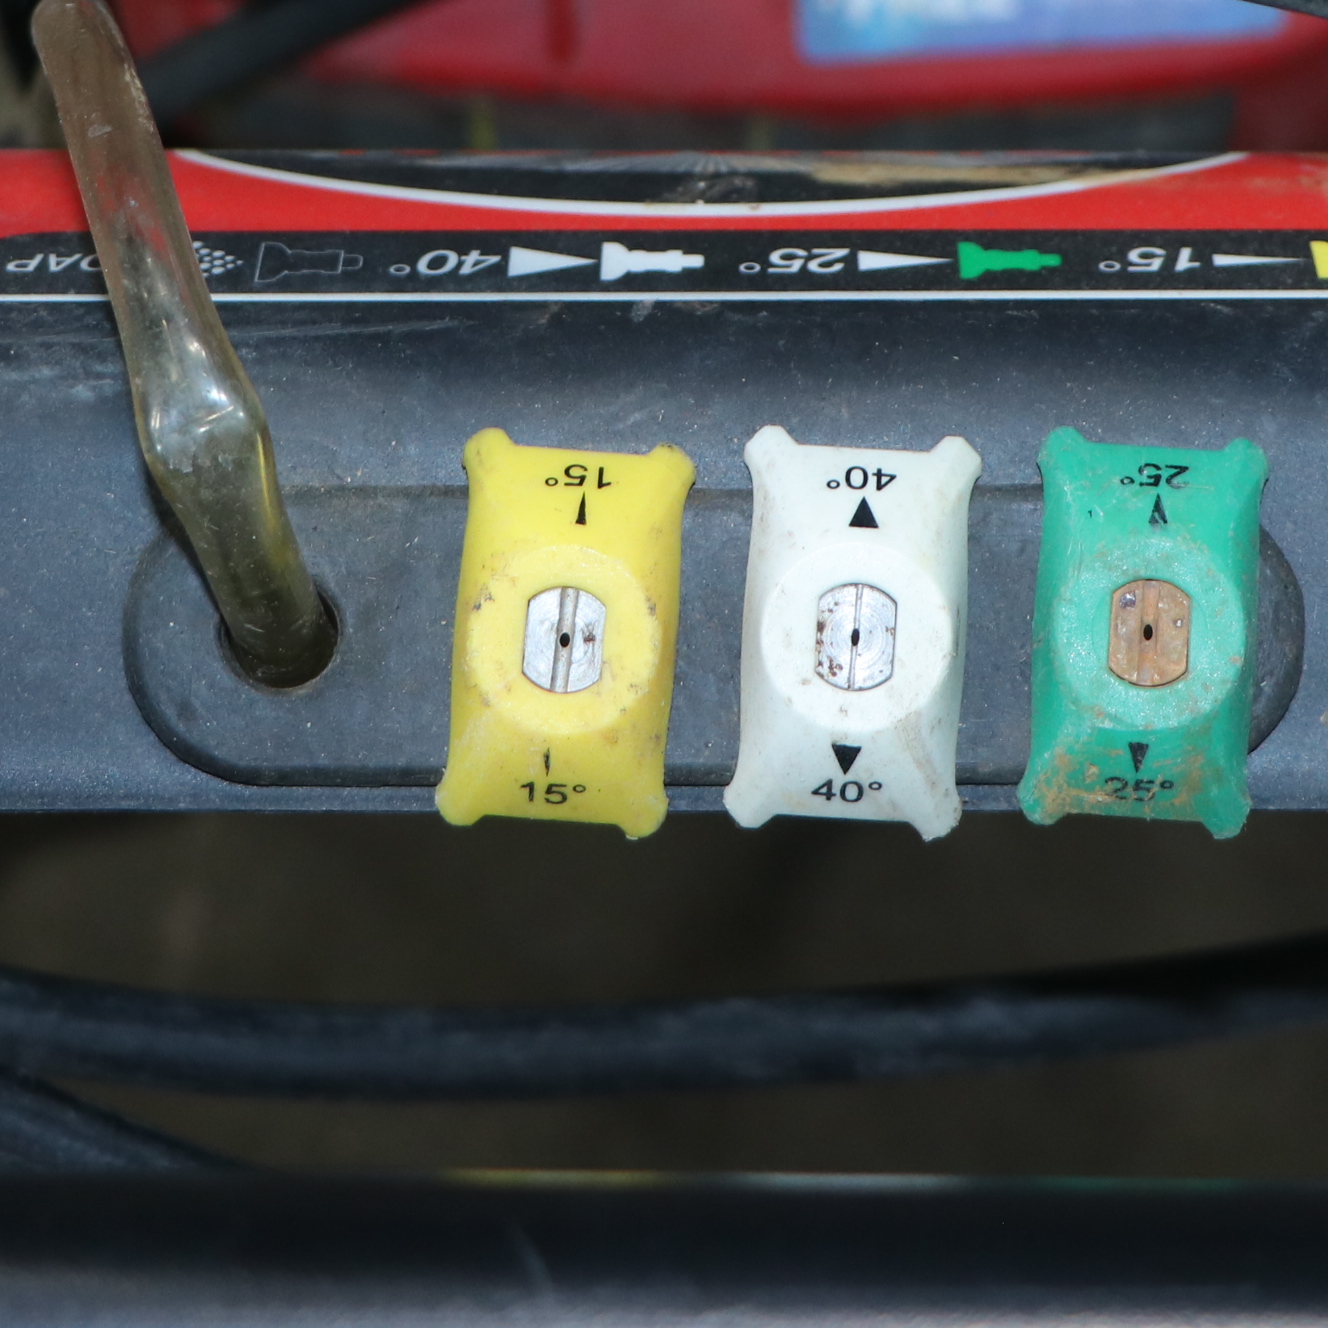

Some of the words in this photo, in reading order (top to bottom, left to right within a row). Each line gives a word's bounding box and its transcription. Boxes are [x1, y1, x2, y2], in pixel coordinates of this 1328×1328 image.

[5, 252, 101, 273] OAP
[389, 249, 501, 275] 40°
[739, 247, 851, 274] 25°
[1099, 246, 1201, 274] 15°
[546, 464, 613, 490] 15°
[826, 465, 897, 491] 40°
[1119, 462, 1190, 489] 25°
[517, 780, 587, 805] 15°
[811, 780, 882, 804] 40°
